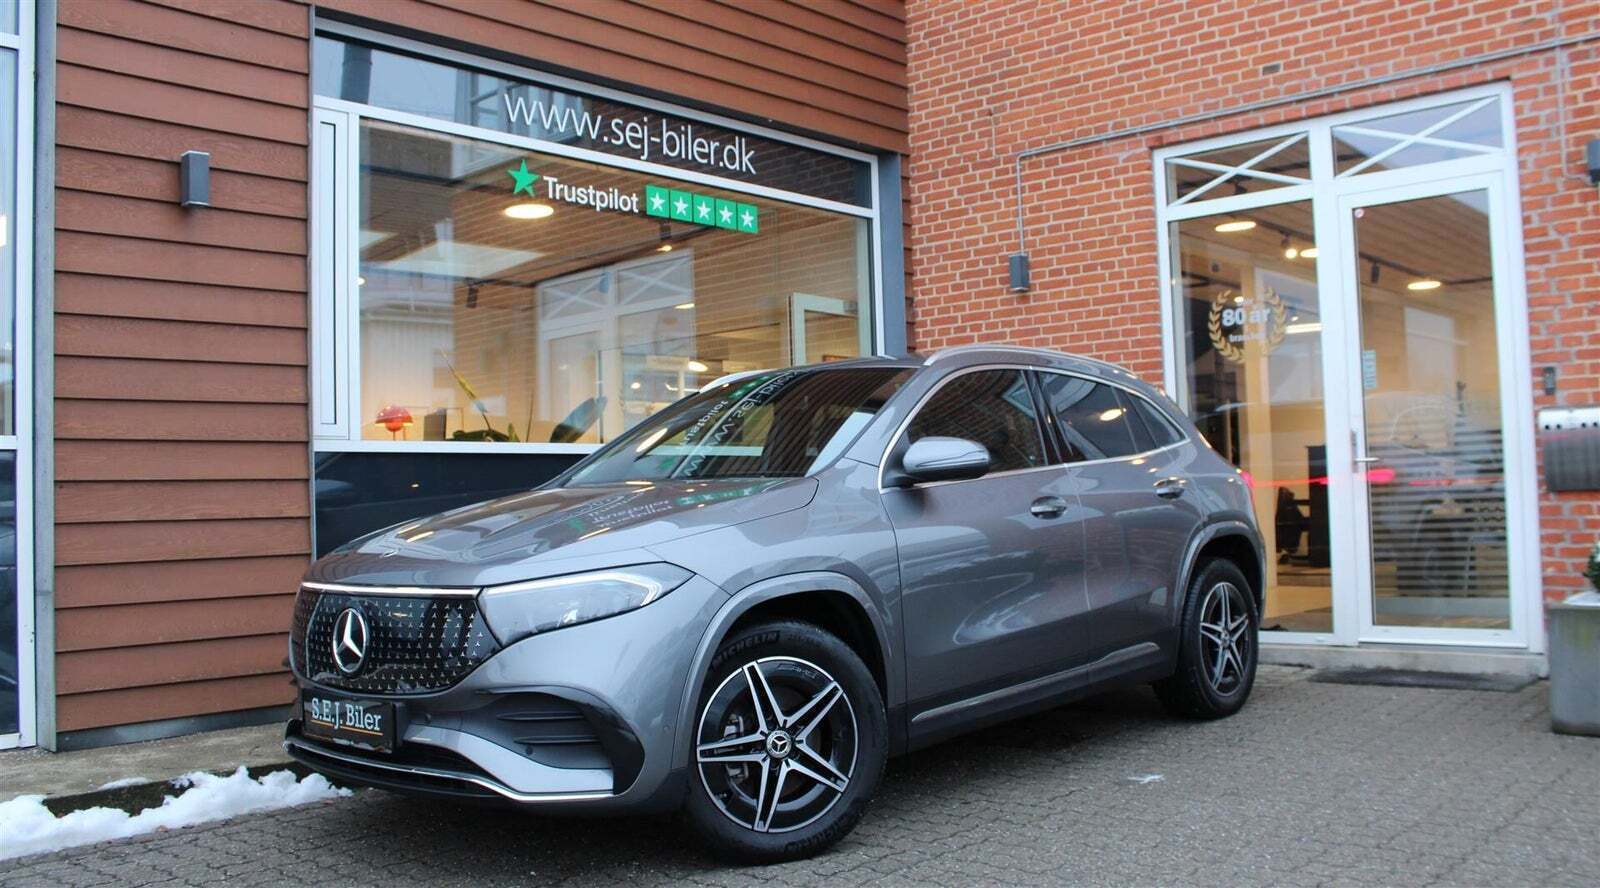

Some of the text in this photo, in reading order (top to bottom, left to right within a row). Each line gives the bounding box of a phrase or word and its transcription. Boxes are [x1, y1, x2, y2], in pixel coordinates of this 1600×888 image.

[504, 93, 756, 175] www.sej-biler.dk
[543, 175, 639, 214] Trustpilot
[1221, 308, 1245, 327] 80
[711, 631, 778, 669] MICHELIN
[311, 697, 382, 731] S.E.J. Biler
